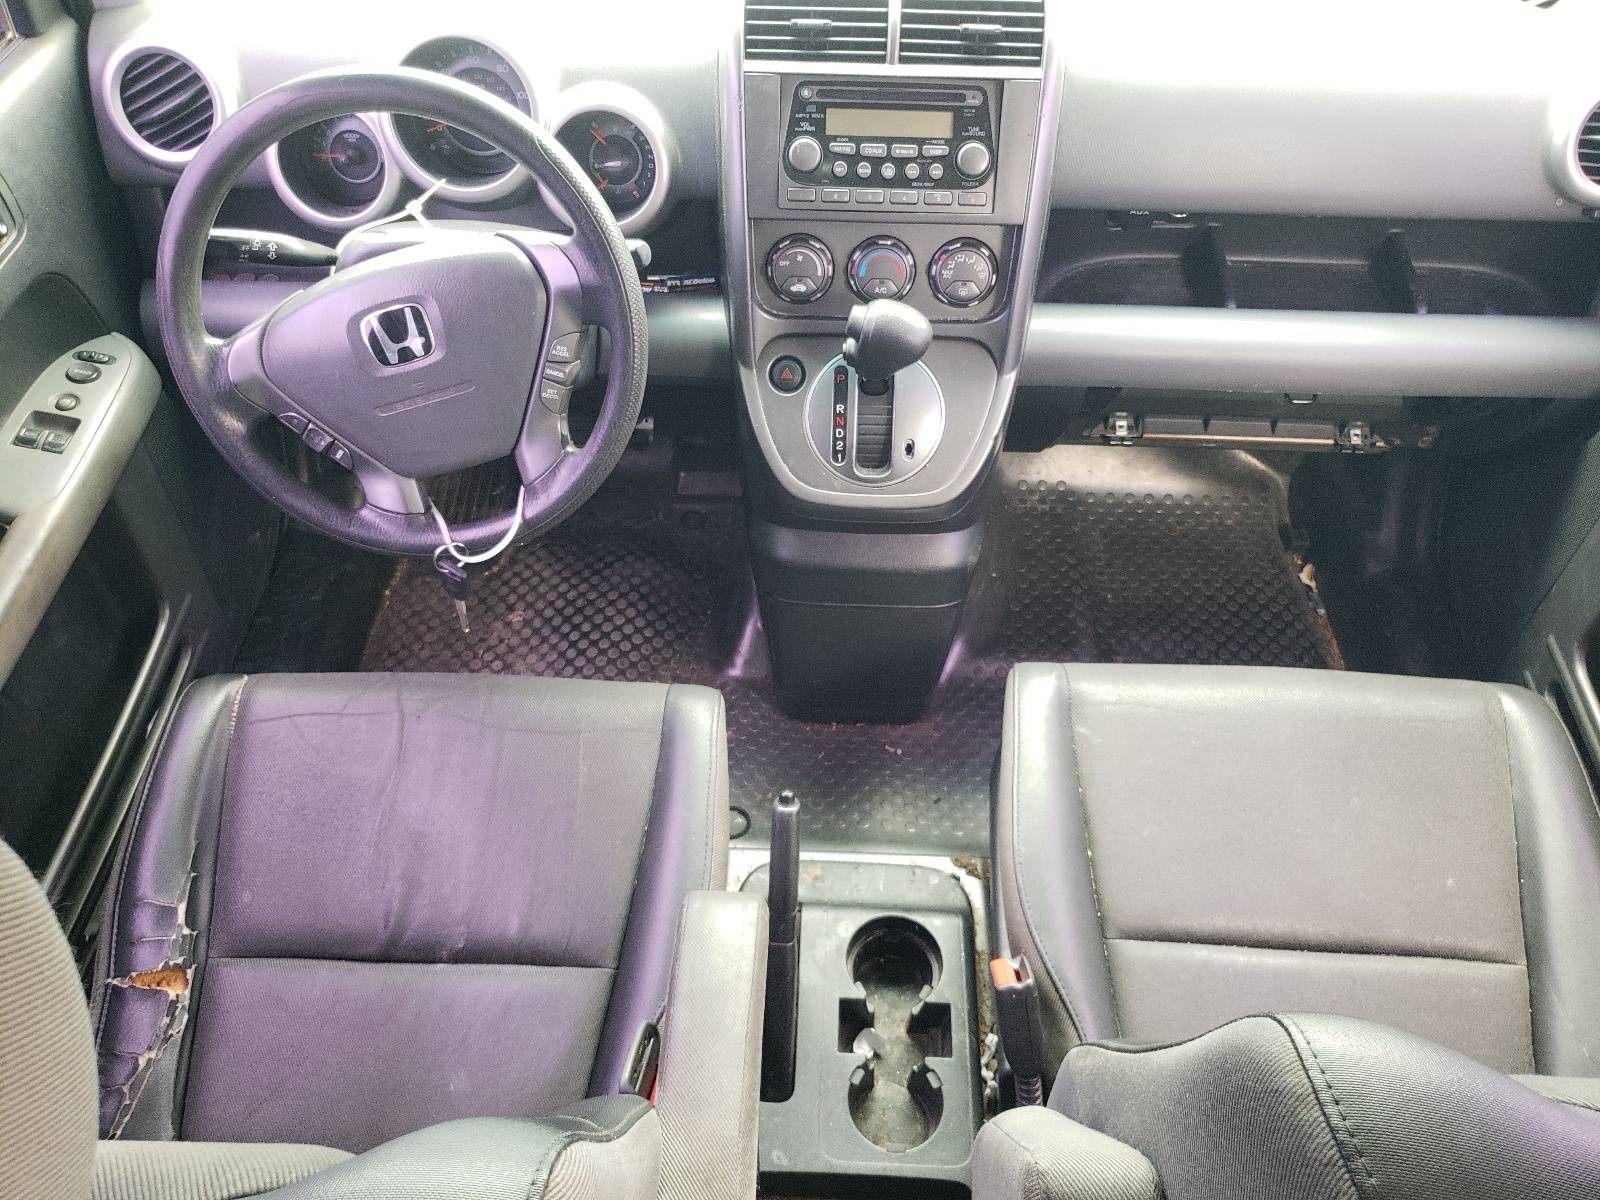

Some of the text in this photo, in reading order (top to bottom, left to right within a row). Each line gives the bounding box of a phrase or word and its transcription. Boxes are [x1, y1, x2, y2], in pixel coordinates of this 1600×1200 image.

[496, 64, 509, 73] 80
[874, 286, 887, 295] A/C
[552, 350, 569, 358] ACCEL
[546, 369, 565, 378] CANCEL
[837, 374, 846, 383] P
[836, 404, 845, 414] R
[836, 416, 845, 426] N
[835, 428, 844, 438] D
[836, 441, 844, 450] 2
[837, 453, 843, 463] 1
